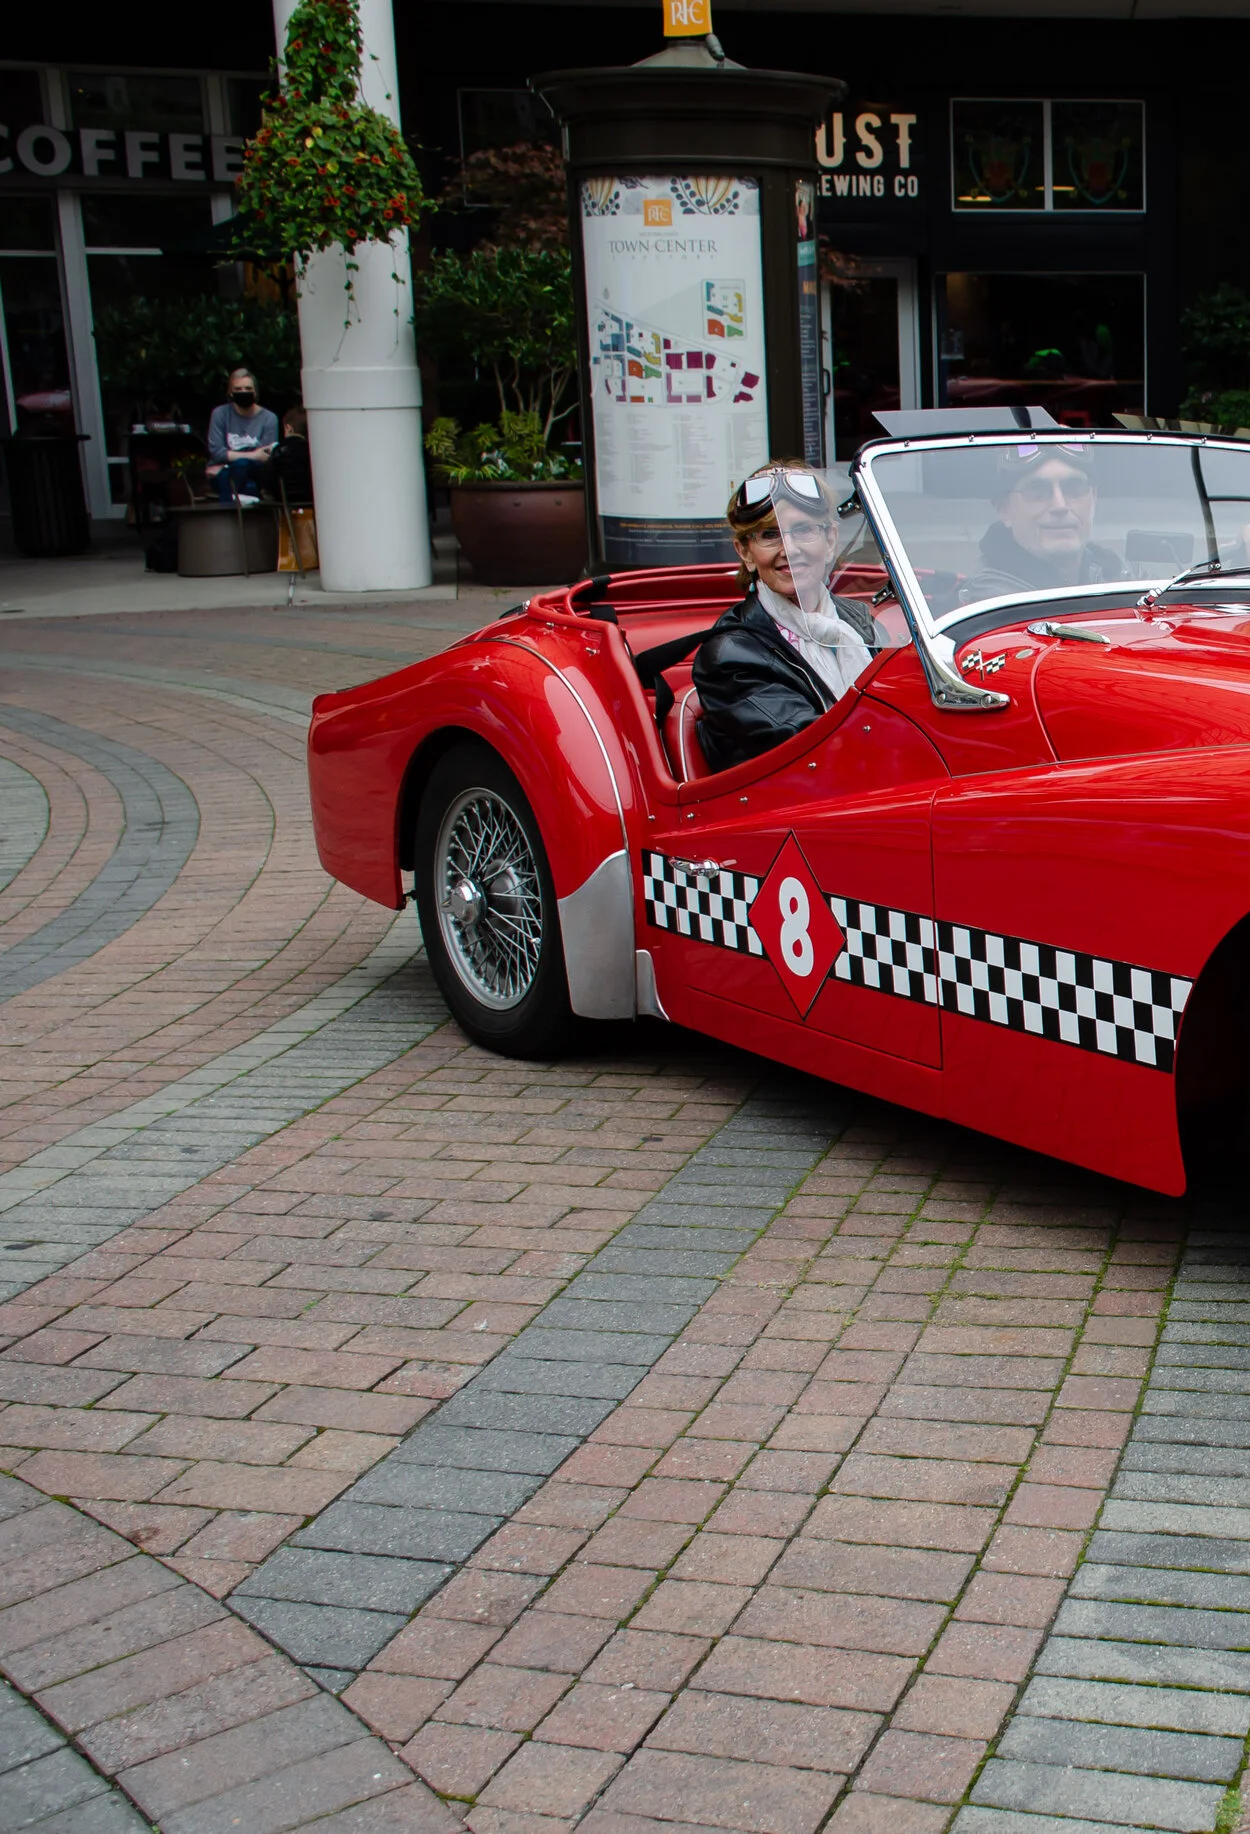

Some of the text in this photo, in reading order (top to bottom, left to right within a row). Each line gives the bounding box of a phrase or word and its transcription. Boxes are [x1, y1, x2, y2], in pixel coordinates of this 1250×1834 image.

[815, 112, 917, 168] UST
[817, 175, 918, 197] EWING CO
[609, 239, 718, 253] TOWN CENTER
[778, 876, 815, 977] 8
